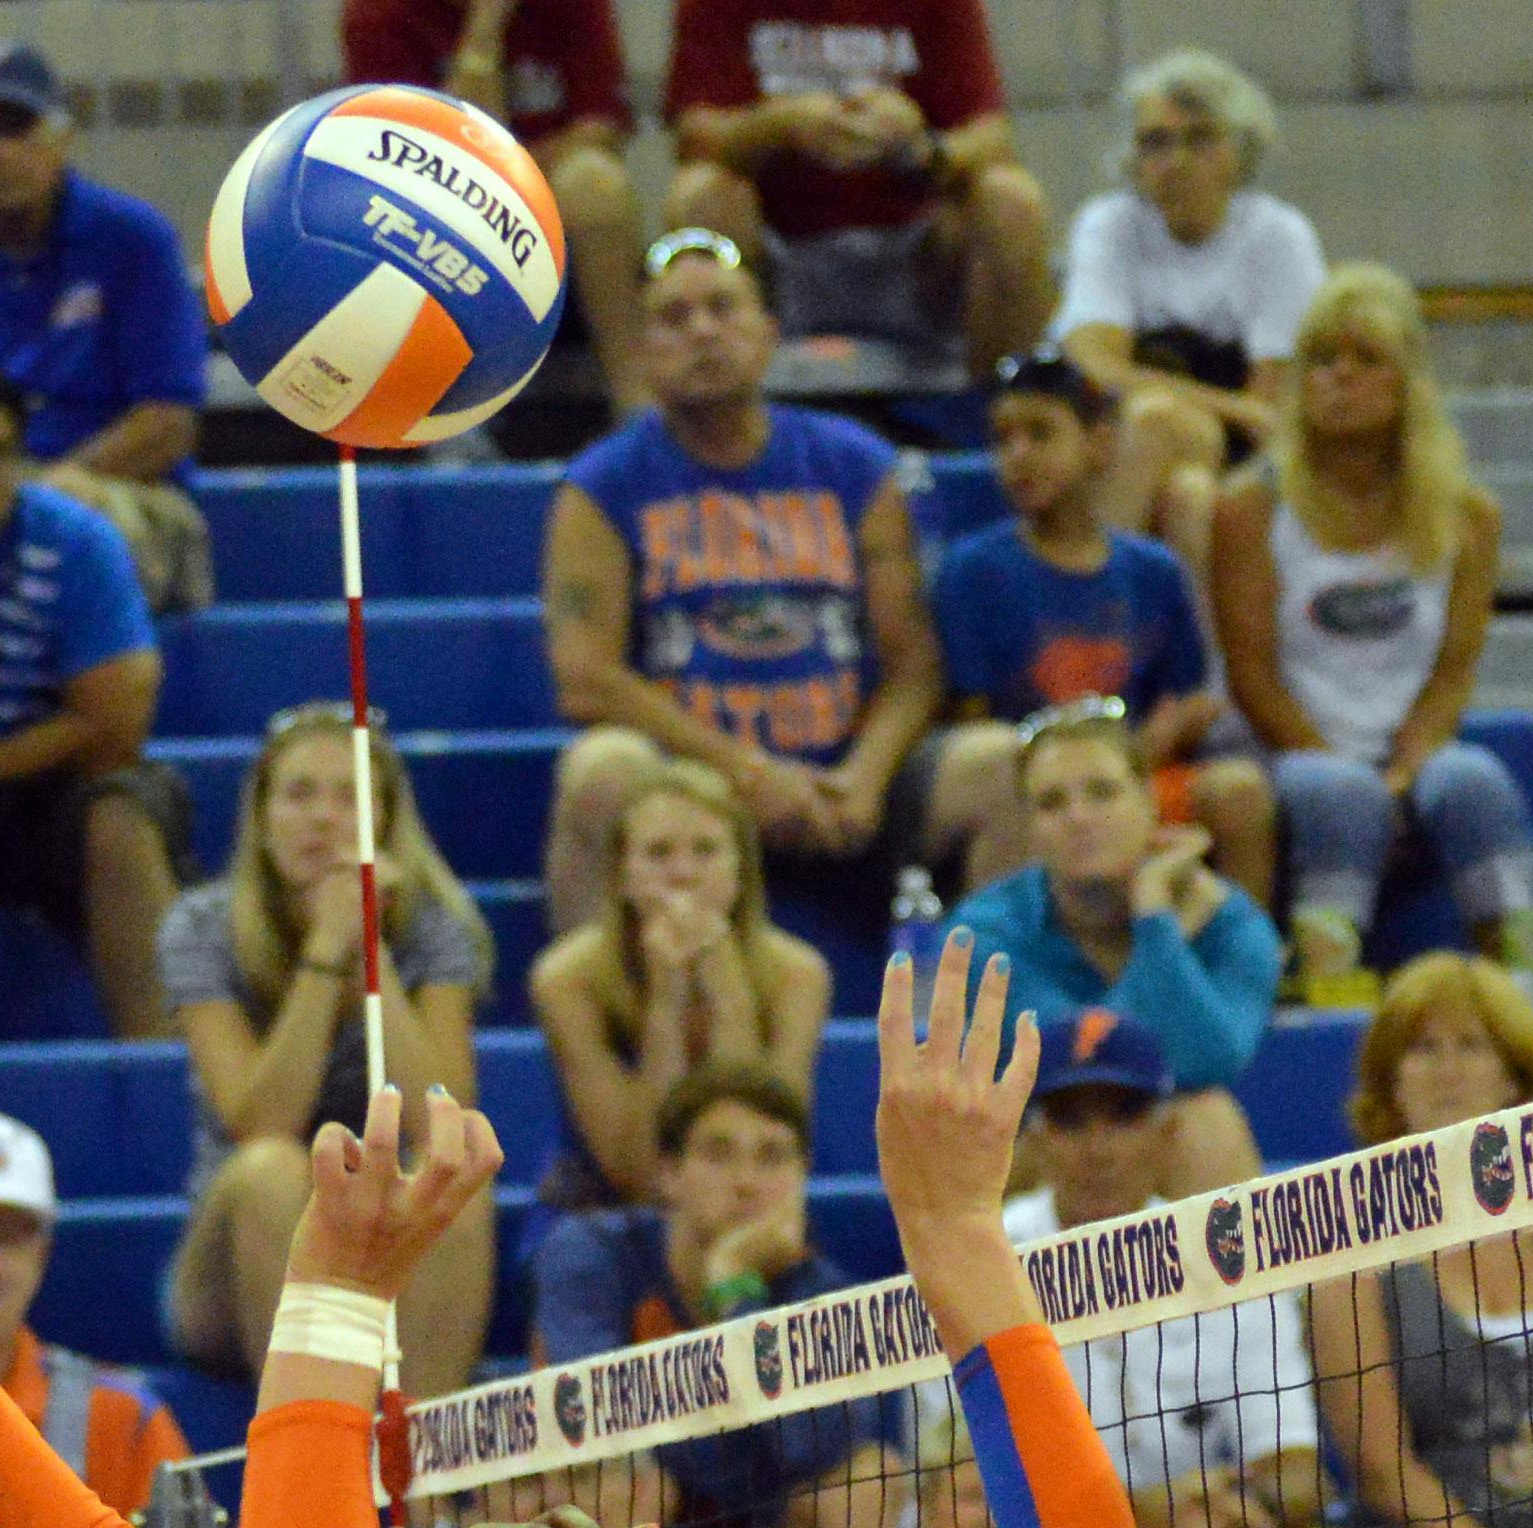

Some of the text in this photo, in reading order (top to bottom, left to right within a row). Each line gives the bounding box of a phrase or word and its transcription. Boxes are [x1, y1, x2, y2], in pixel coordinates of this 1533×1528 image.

[367, 130, 538, 269] SPALDING
[1250, 1141, 1443, 1272] FLORIDA GATORS
[1097, 1214, 1185, 1310] GATORS
[663, 1334, 729, 1418] GATORS
[787, 1299, 871, 1388] FLORIDA
